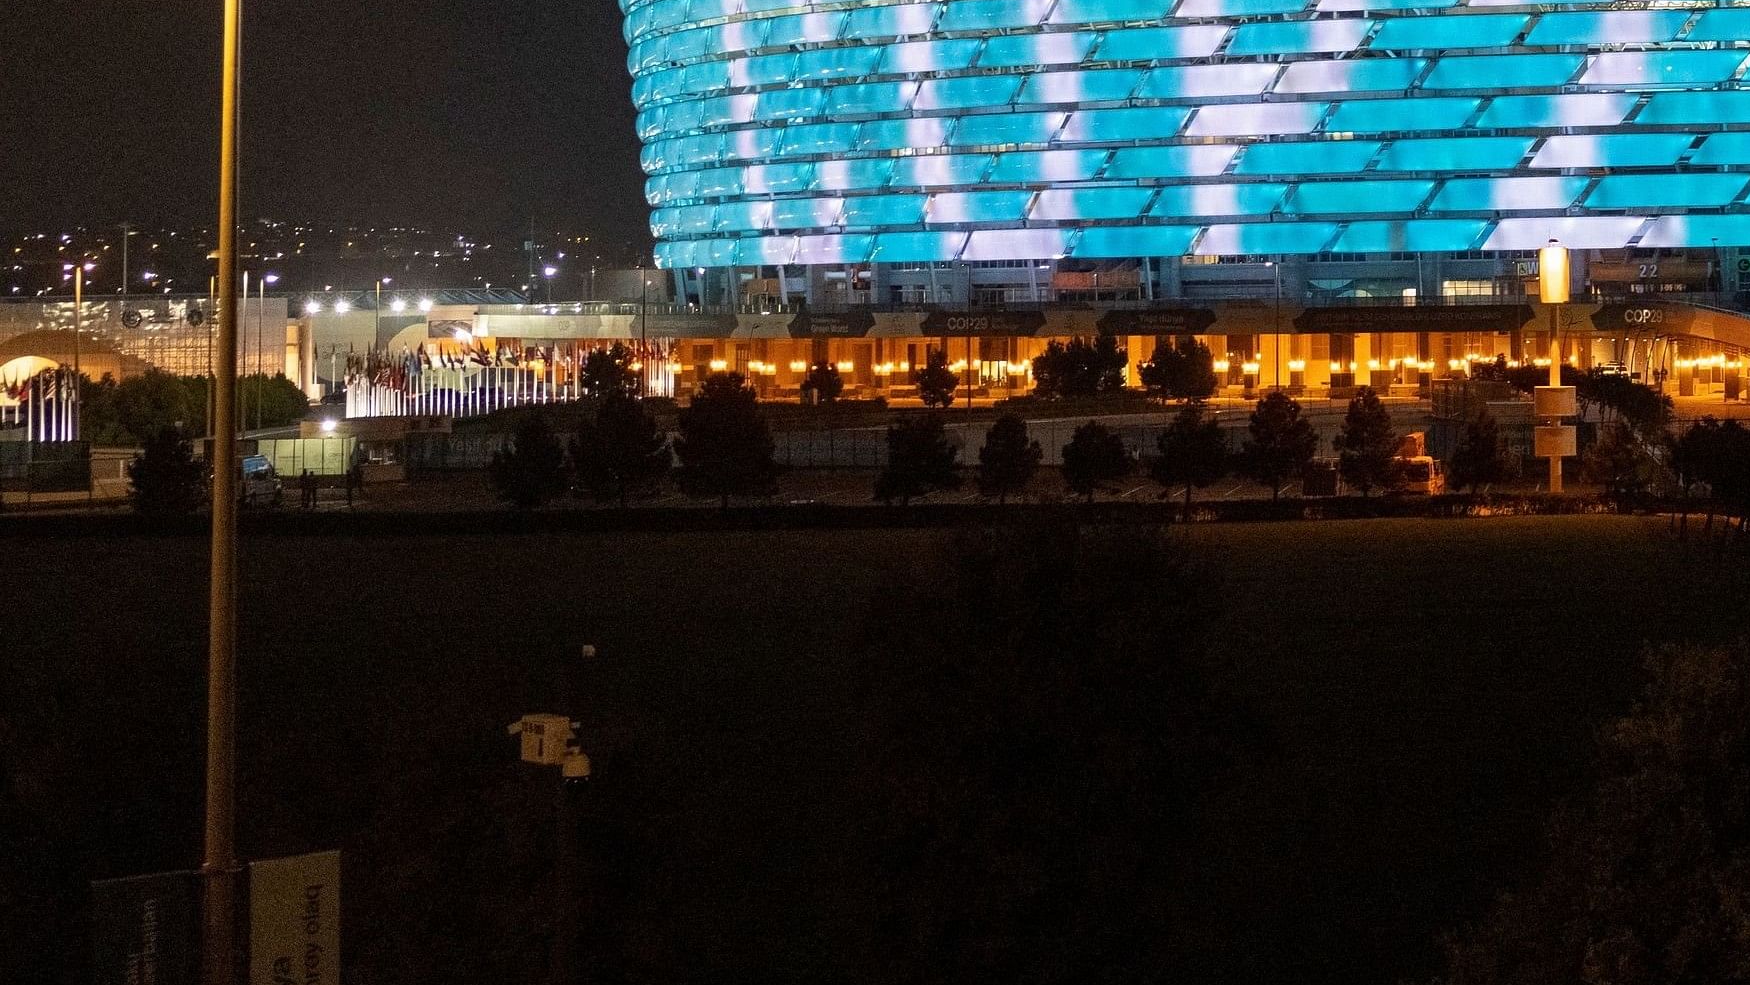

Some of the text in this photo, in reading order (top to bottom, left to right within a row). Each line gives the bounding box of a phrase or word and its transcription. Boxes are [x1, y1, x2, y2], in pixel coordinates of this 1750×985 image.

[1639, 264, 1657, 278] 22
[1624, 309, 1663, 324] COP29
[946, 317, 989, 331] COP29
